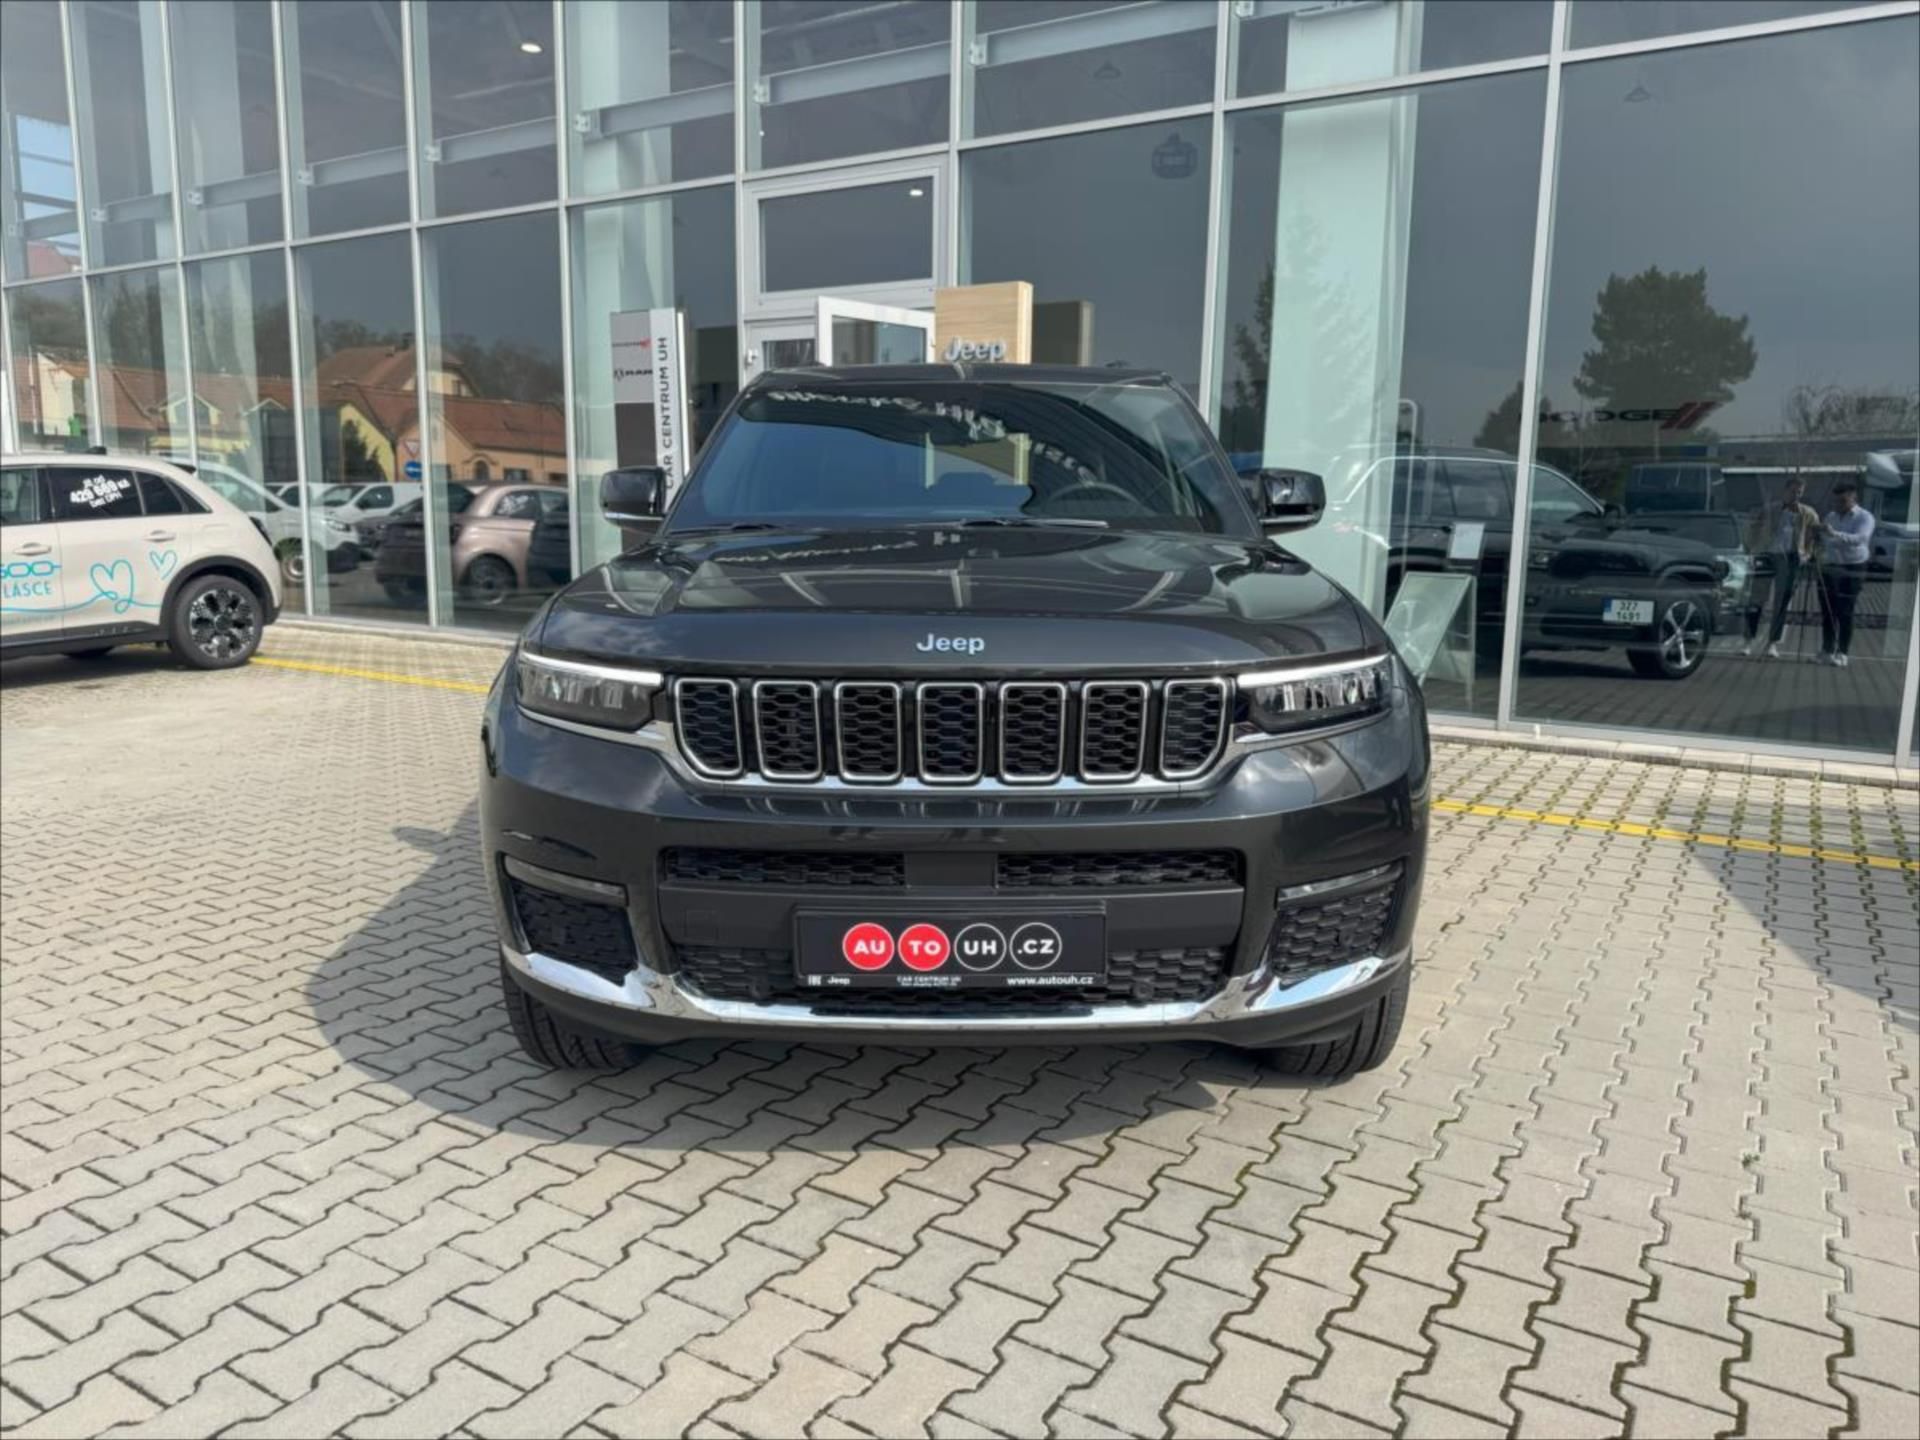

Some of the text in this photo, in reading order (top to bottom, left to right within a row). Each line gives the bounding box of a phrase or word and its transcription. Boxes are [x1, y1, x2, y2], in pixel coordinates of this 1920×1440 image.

[658, 337, 668, 361] UH
[944, 336, 1006, 363] Jeep
[659, 366, 674, 449] CENTRUM
[1519, 409, 1682, 423] ODGE
[916, 632, 985, 656] Jeep
[963, 940, 997, 956] UH
[1006, 975, 1095, 986] www.autouh.cz
